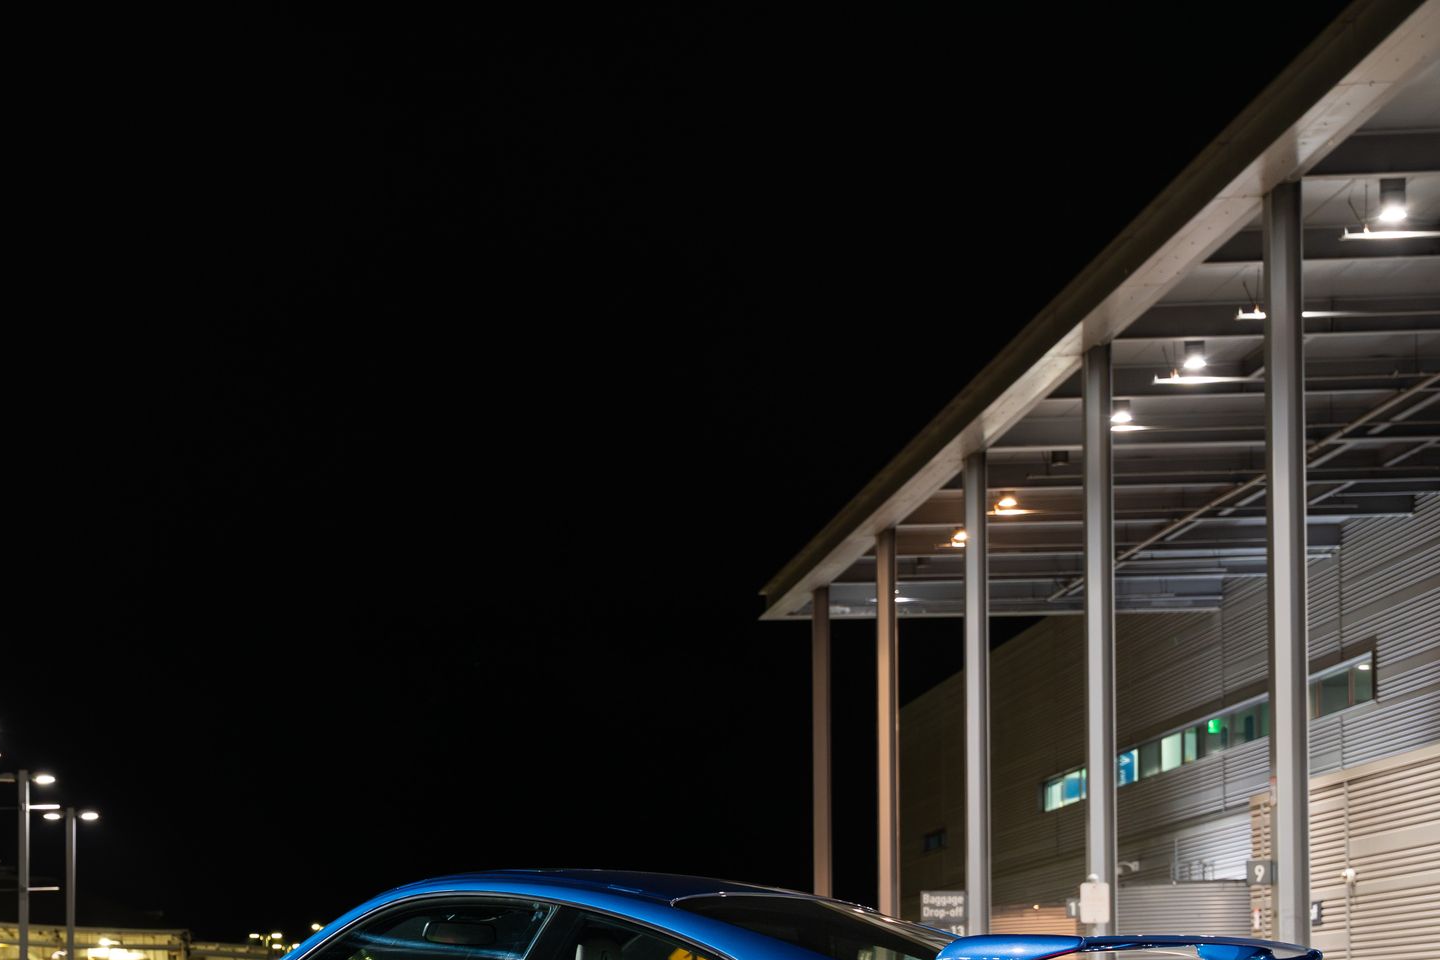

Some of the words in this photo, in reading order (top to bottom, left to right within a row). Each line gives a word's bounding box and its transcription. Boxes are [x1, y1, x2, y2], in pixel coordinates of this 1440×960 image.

[1254, 864, 1265, 882] 9
[922, 893, 964, 906] Baggage
[923, 906, 963, 919] Drop-off
